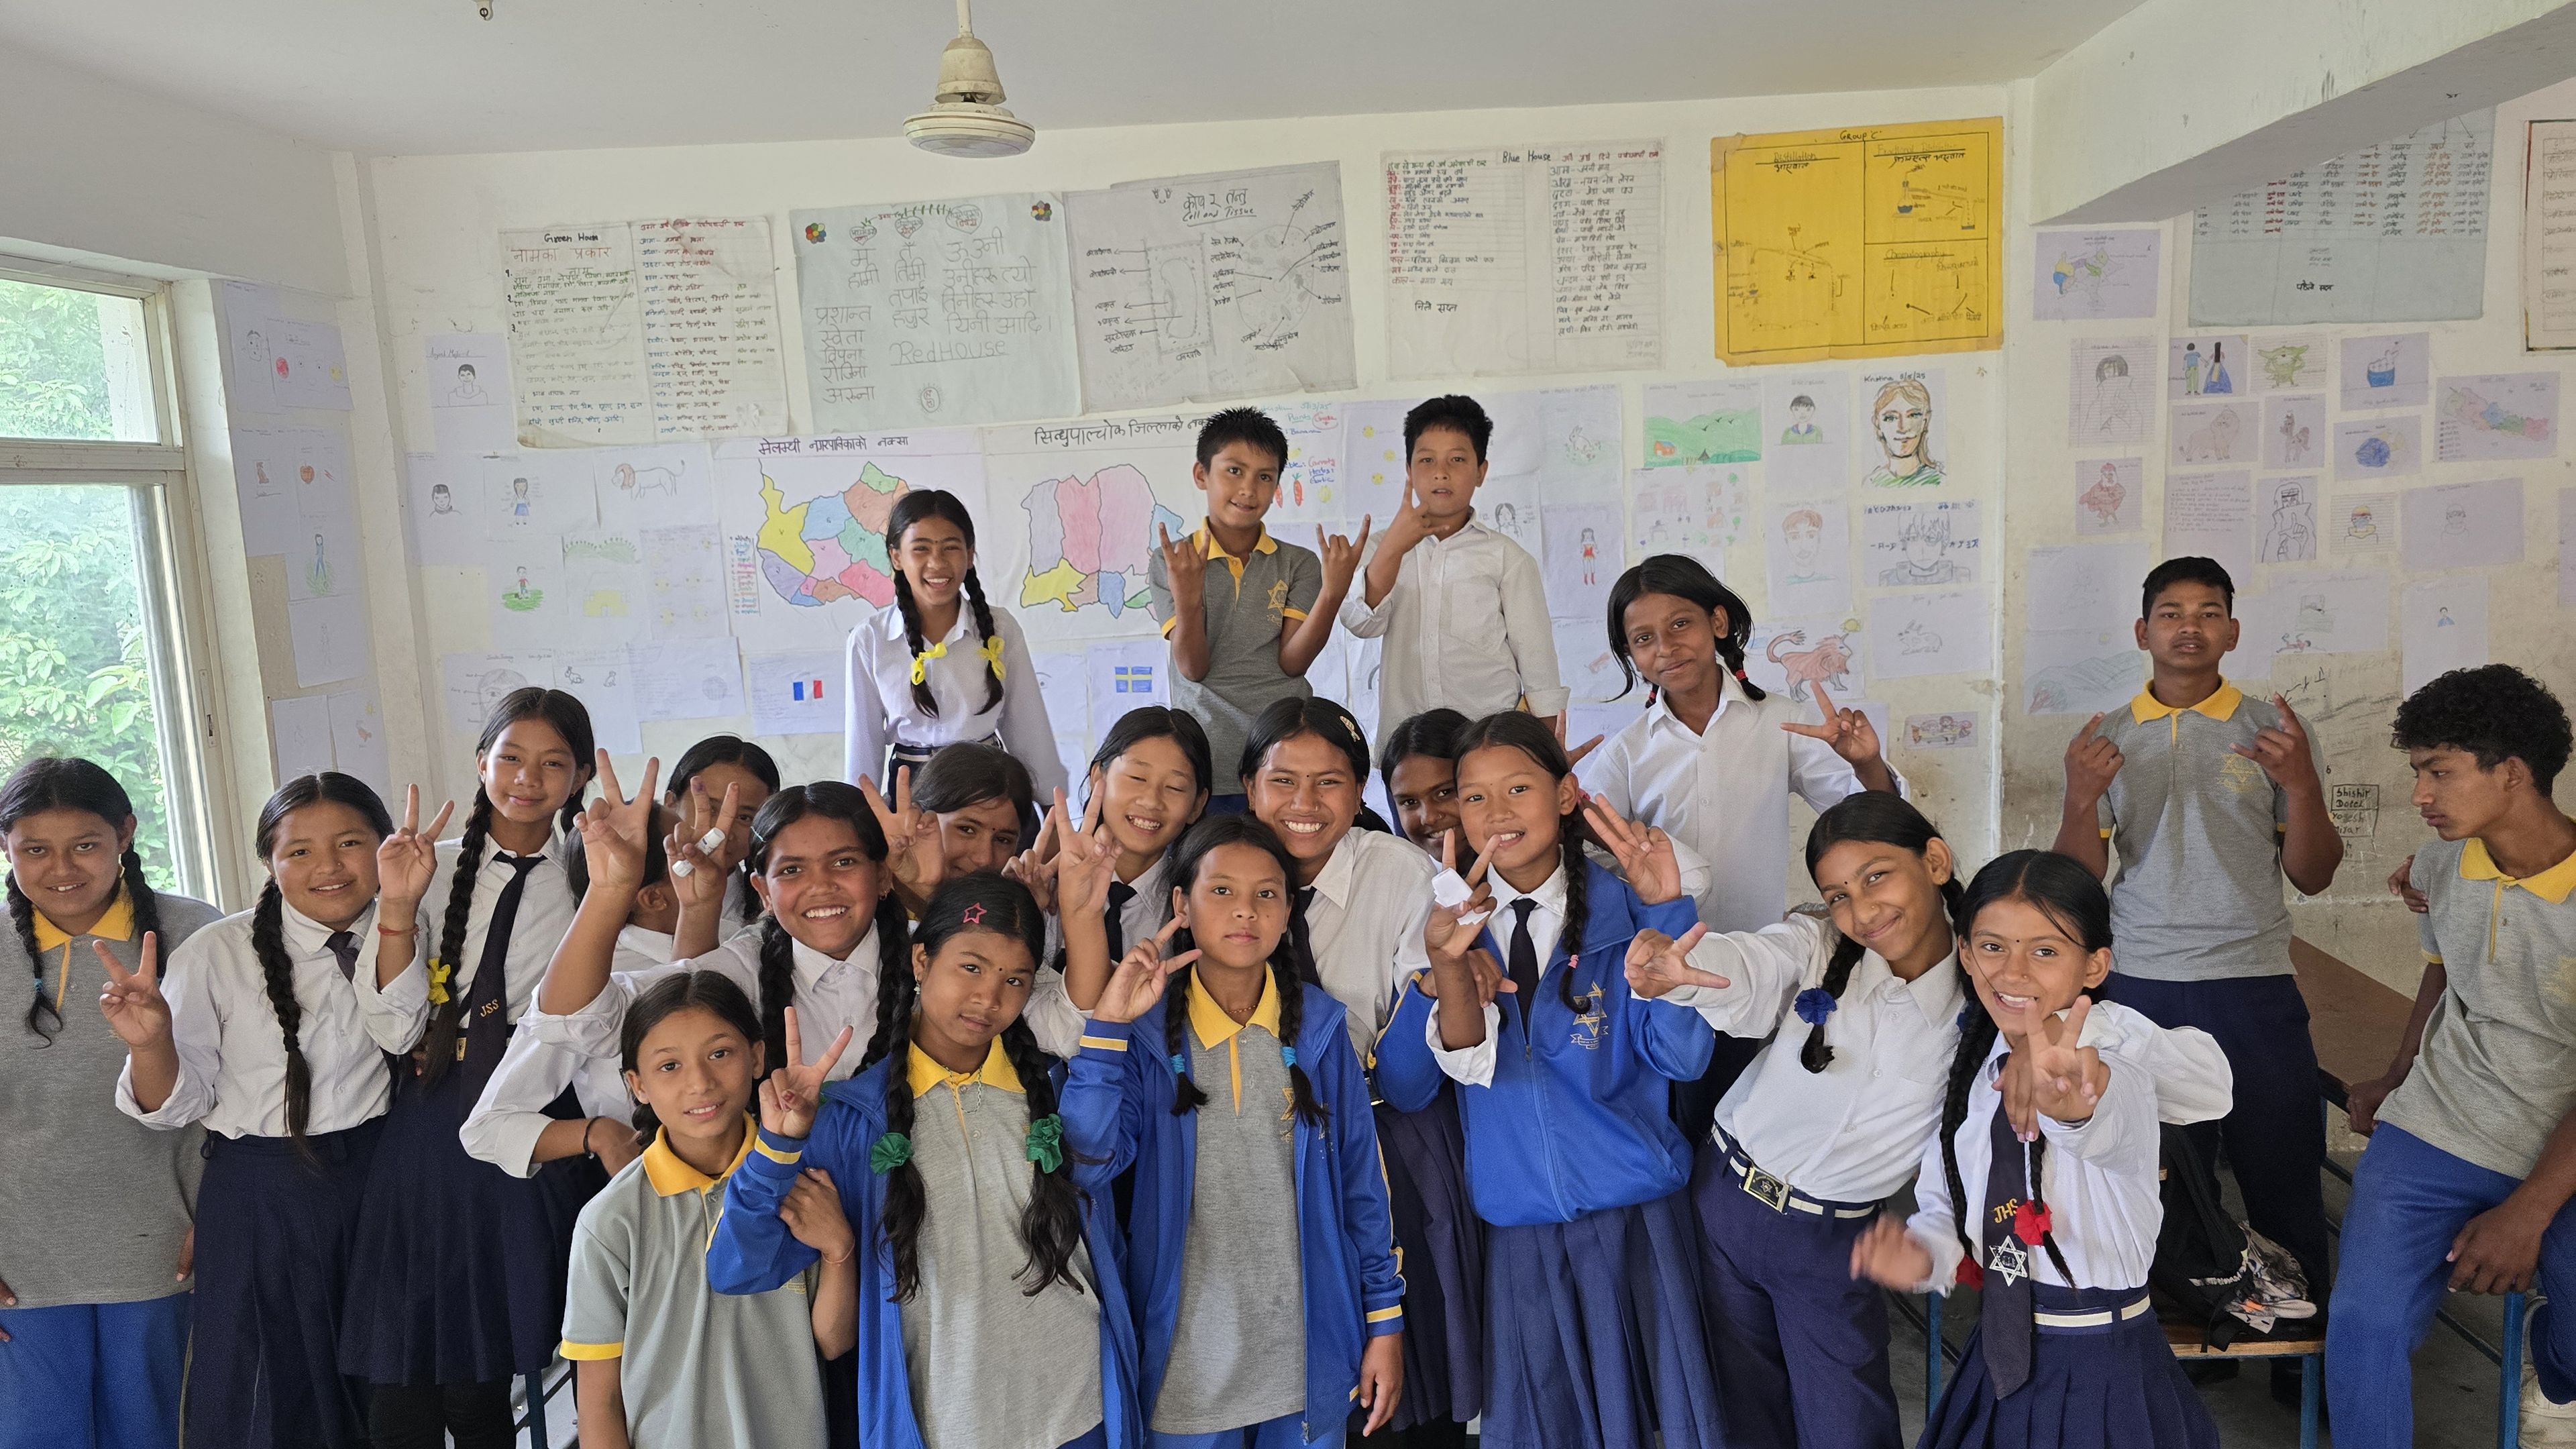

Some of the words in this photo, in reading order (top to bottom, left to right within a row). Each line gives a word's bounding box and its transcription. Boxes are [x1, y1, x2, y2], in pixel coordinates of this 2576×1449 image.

[1502, 150, 1521, 163] Blue
[1527, 150, 1552, 163] House
[1203, 207, 1218, 219] and
[1225, 205, 1254, 218] Tissue
[480, 998, 499, 1018] JSS
